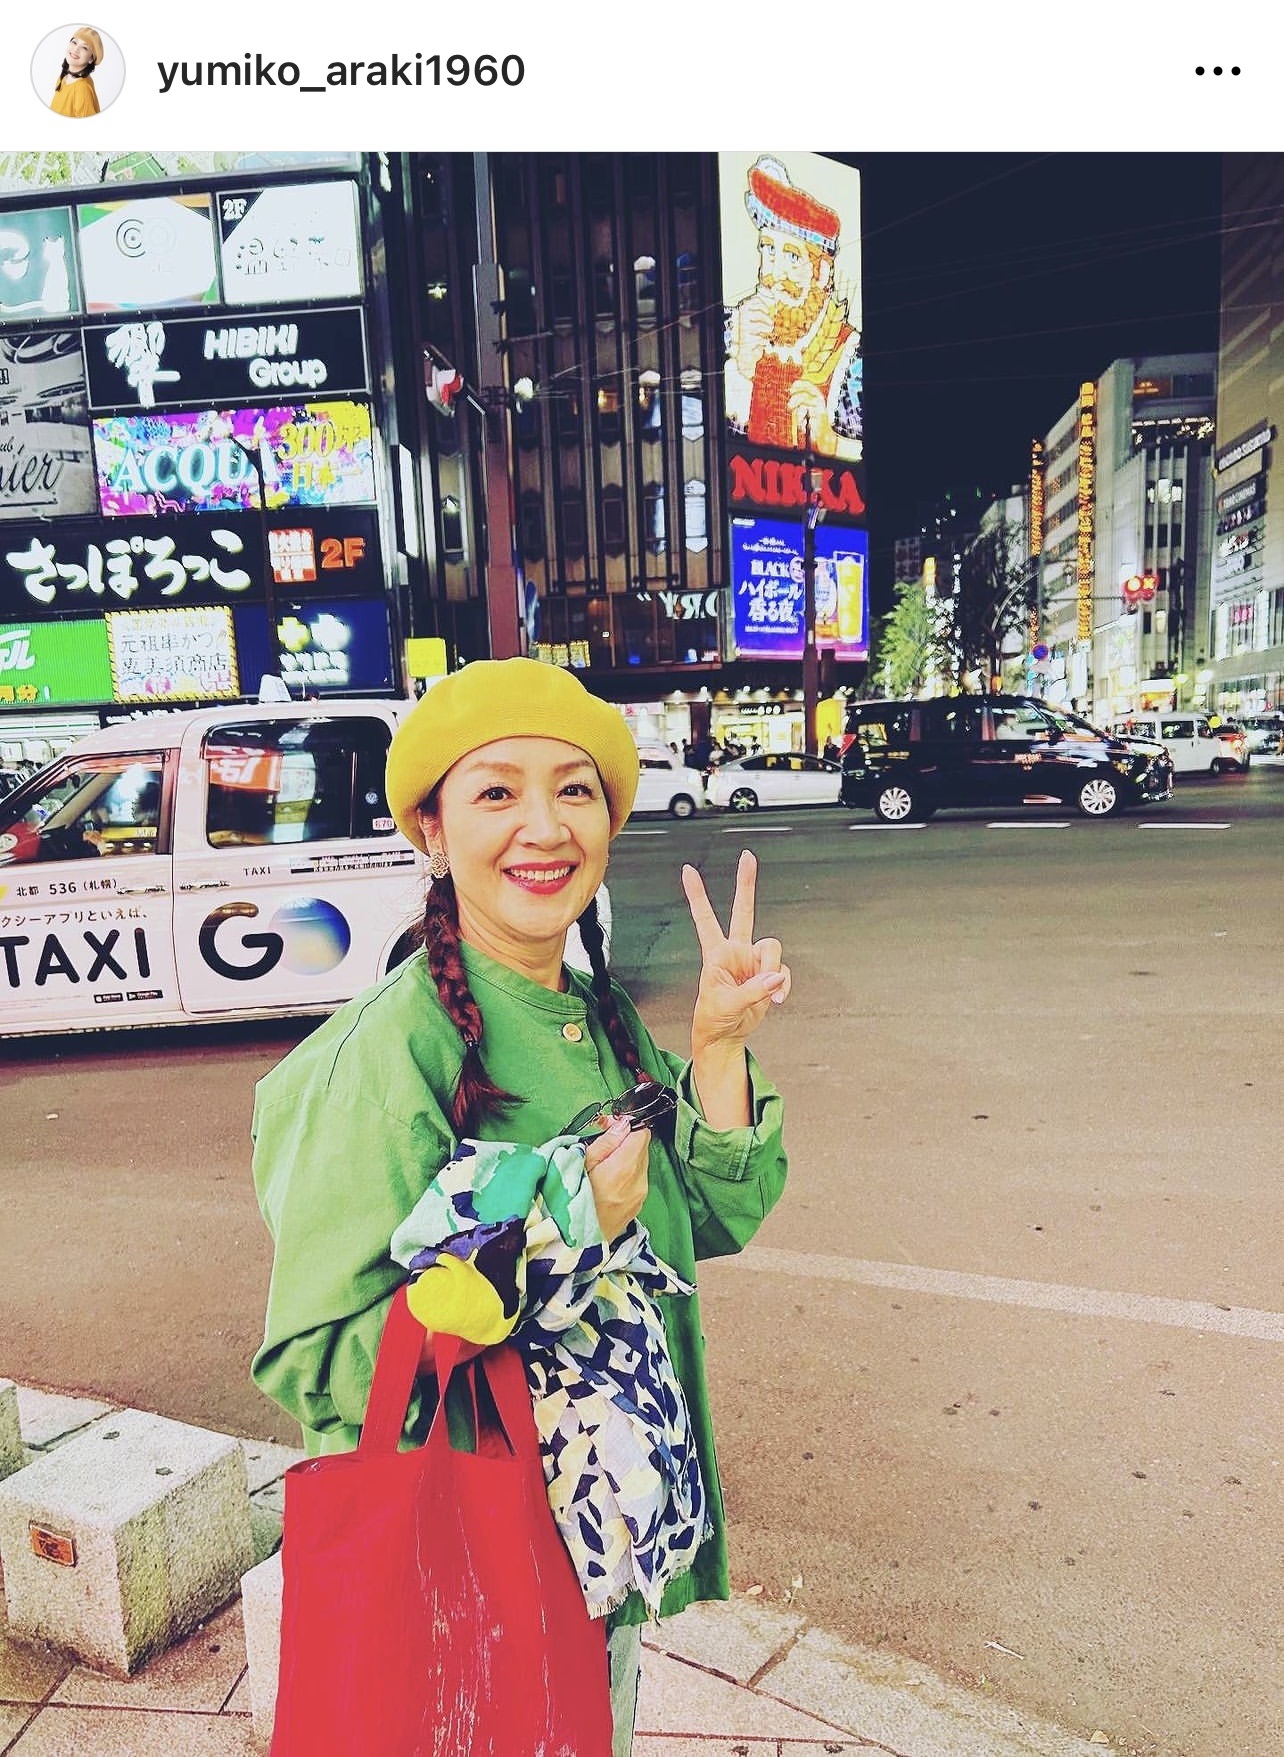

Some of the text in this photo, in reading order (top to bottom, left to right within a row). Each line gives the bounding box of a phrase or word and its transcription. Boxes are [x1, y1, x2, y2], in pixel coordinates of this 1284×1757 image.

[223, 198, 247, 221] 2F
[203, 324, 299, 360] HIBIKI
[249, 358, 328, 389] Group
[111, 438, 281, 496] ACQUA
[729, 454, 865, 514] NIKKA
[6, 529, 251, 603] さっぽろっこ
[321, 537, 365, 569] 2F
[49, 881, 77, 895] 536
[243, 866, 272, 877] TAXI
[0, 928, 151, 988] TAXI
